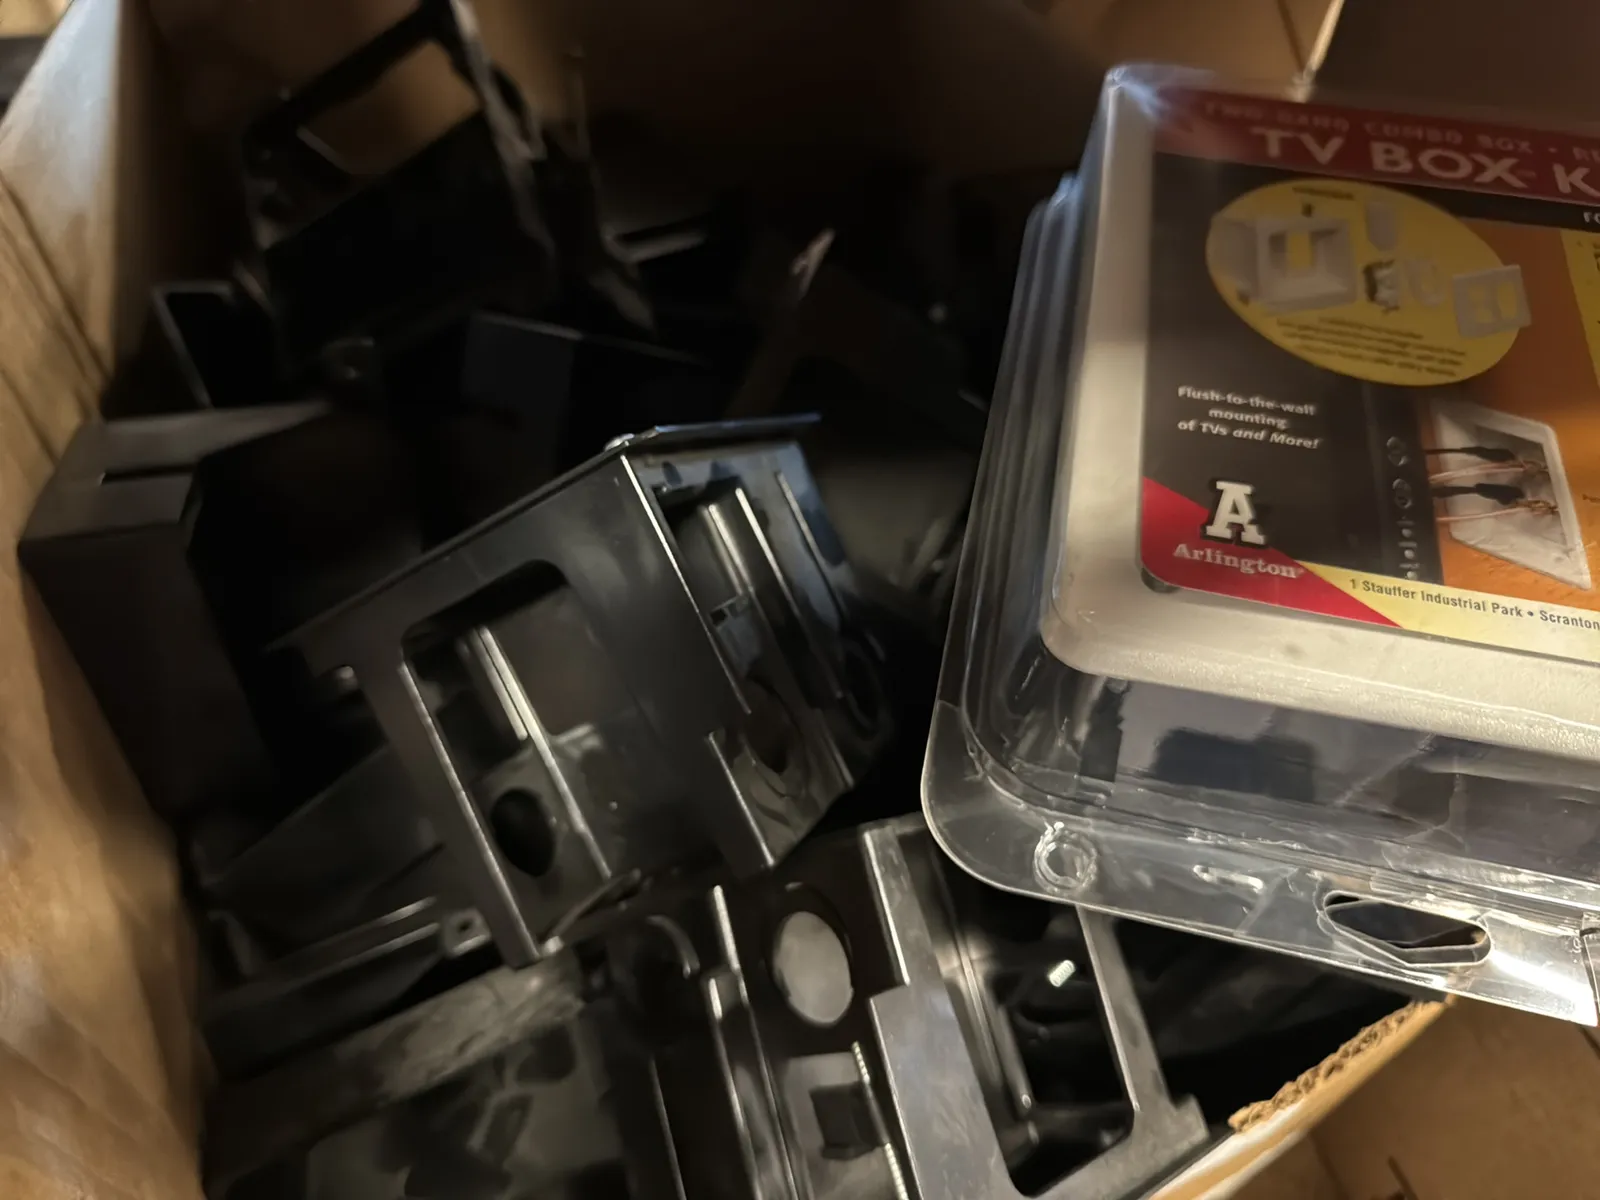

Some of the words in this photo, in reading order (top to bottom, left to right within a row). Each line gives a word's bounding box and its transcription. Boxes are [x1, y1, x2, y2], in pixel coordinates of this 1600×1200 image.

[1249, 126, 1345, 165] TV
[1369, 141, 1530, 189] BOX
[1177, 384, 1316, 416] Flush-to-the-wall
[1209, 407, 1288, 429] mounting
[1178, 419, 1198, 432] of
[1199, 421, 1229, 437] TVs
[1232, 425, 1265, 441] and
[1269, 433, 1322, 449] More!
[1204, 480, 1266, 546] A
[1173, 542, 1299, 579] Arlington
[1350, 577, 1358, 590] 1
[1362, 580, 1416, 601] Stauffer
[1421, 588, 1488, 613] Industrial
[1492, 598, 1523, 617] Park
[1539, 609, 1600, 631] Scranton
